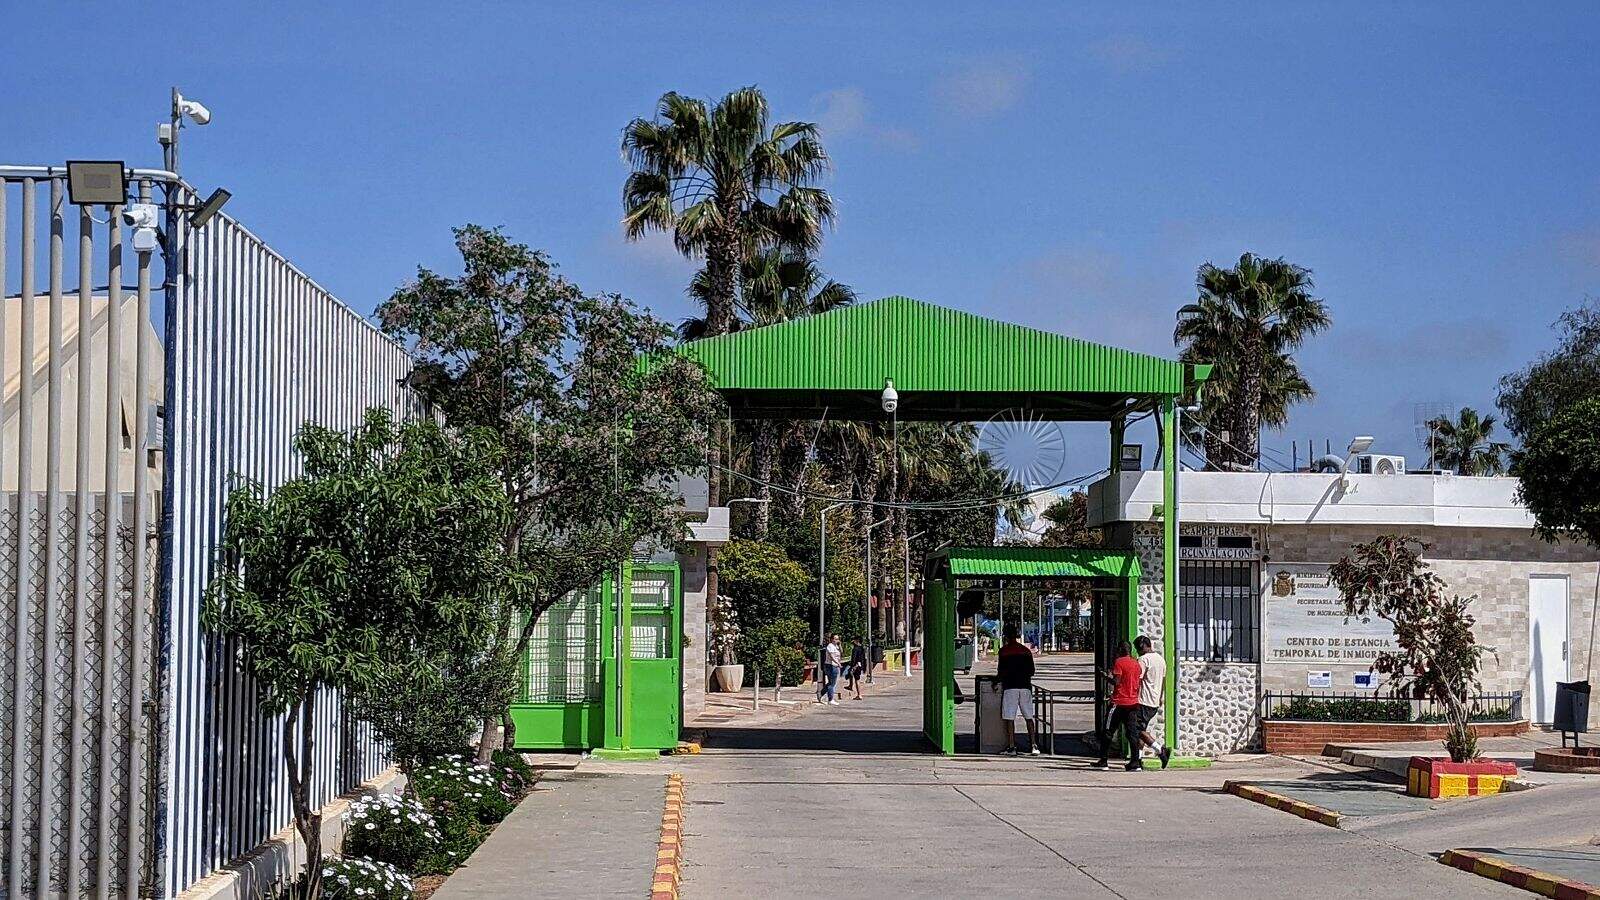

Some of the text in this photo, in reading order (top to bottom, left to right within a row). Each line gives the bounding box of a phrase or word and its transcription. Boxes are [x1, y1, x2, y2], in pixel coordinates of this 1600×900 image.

[1204, 536, 1216, 547] DE
[1286, 637, 1390, 647] CENTRO DE ESTANCIA
[1272, 649, 1324, 658] TEMPORAL
[1327, 649, 1341, 658] DE
